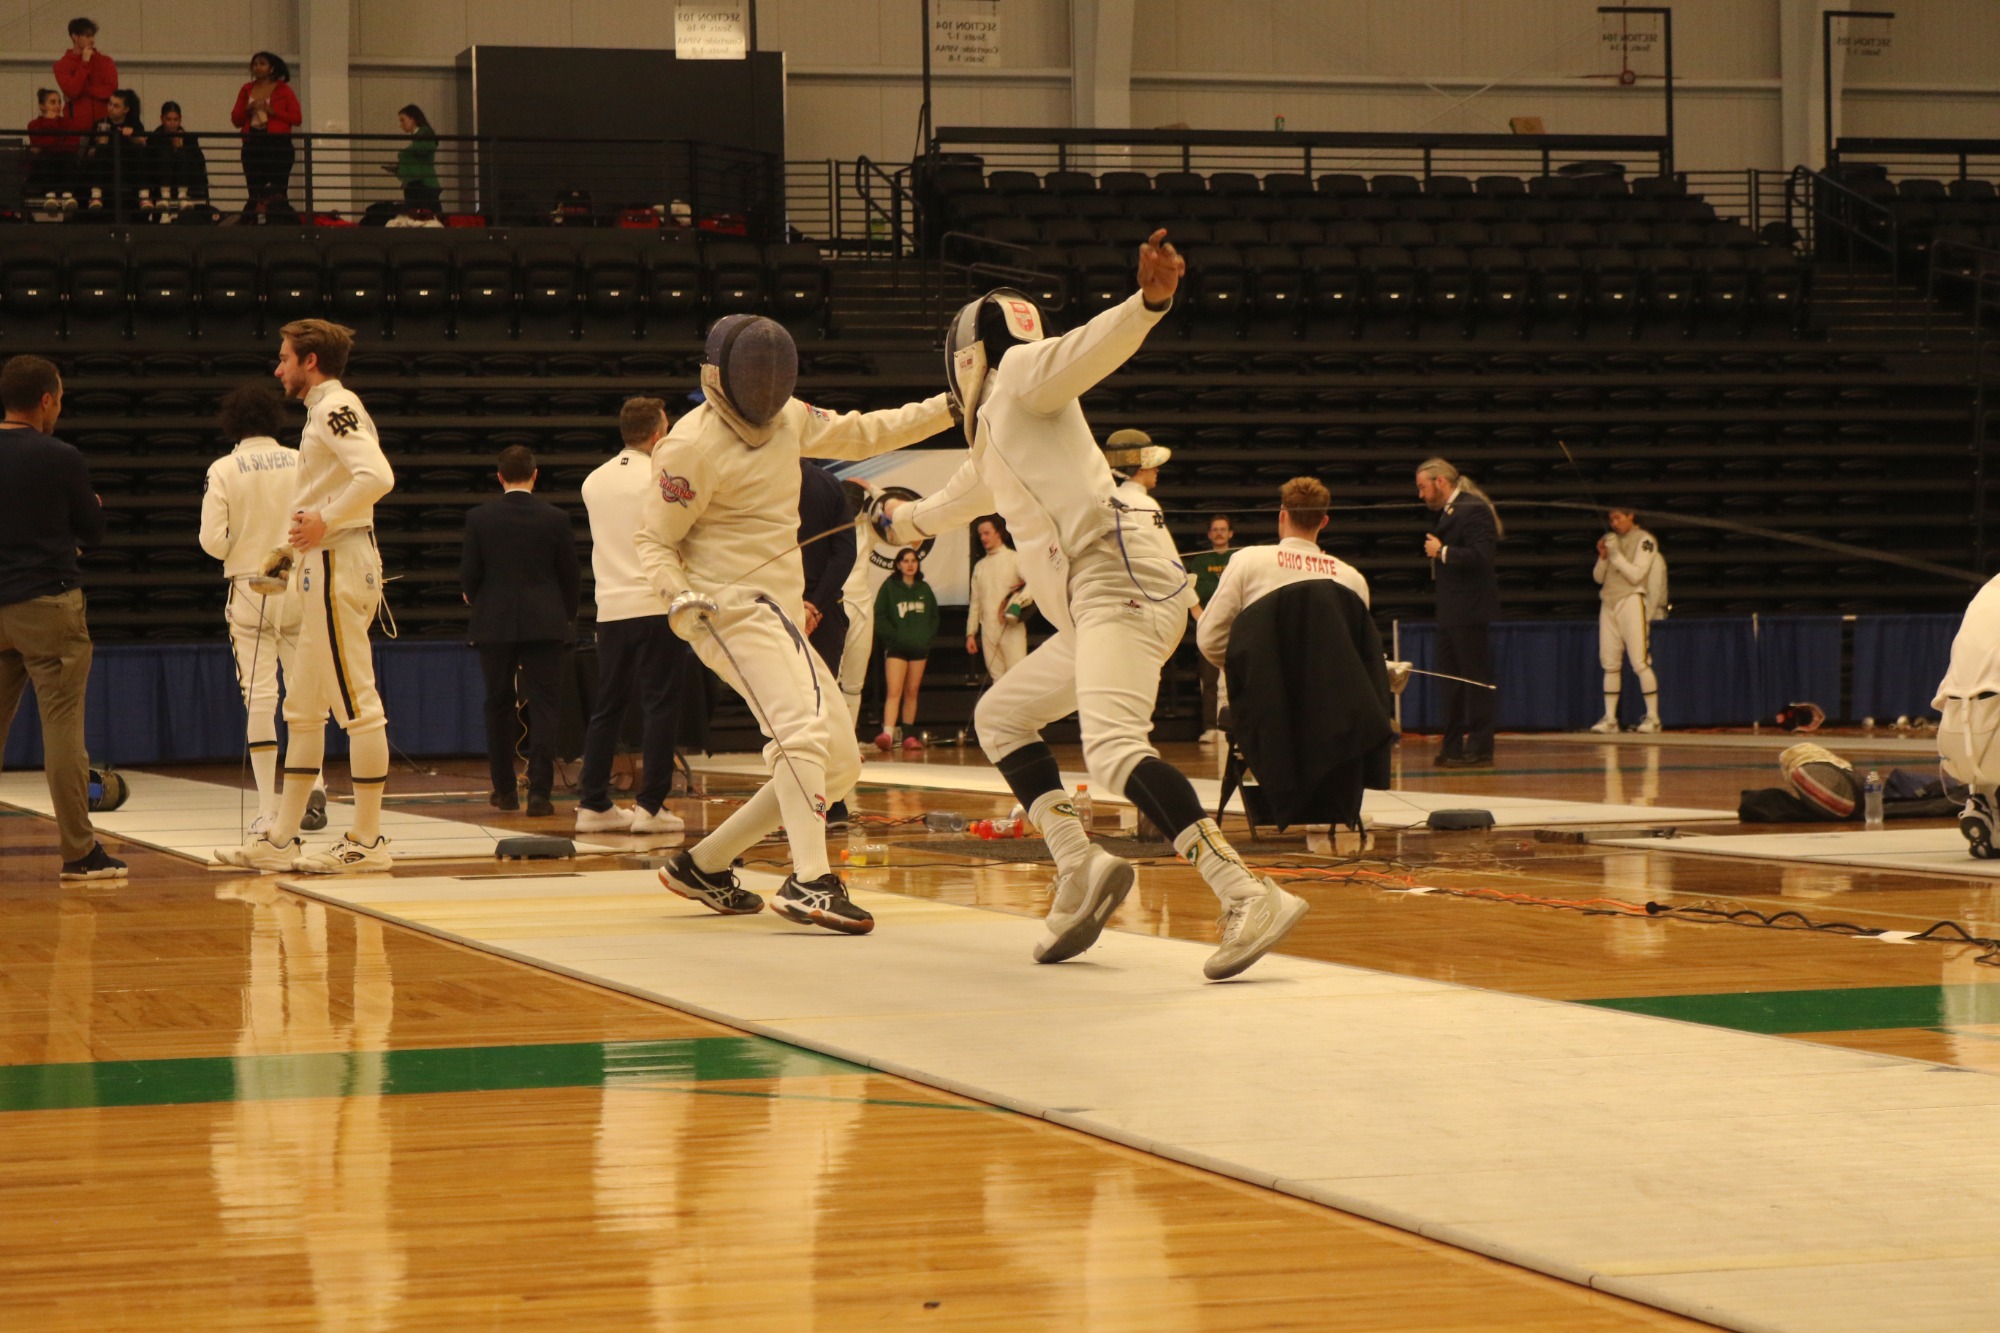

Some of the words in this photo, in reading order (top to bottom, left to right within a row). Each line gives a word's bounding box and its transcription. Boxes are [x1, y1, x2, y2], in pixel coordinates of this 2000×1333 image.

[236, 455, 251, 474] N.
[250, 450, 296, 472] SILVERS
[1277, 550, 1303, 570] OHIO
[1305, 555, 1337, 576] STATE
